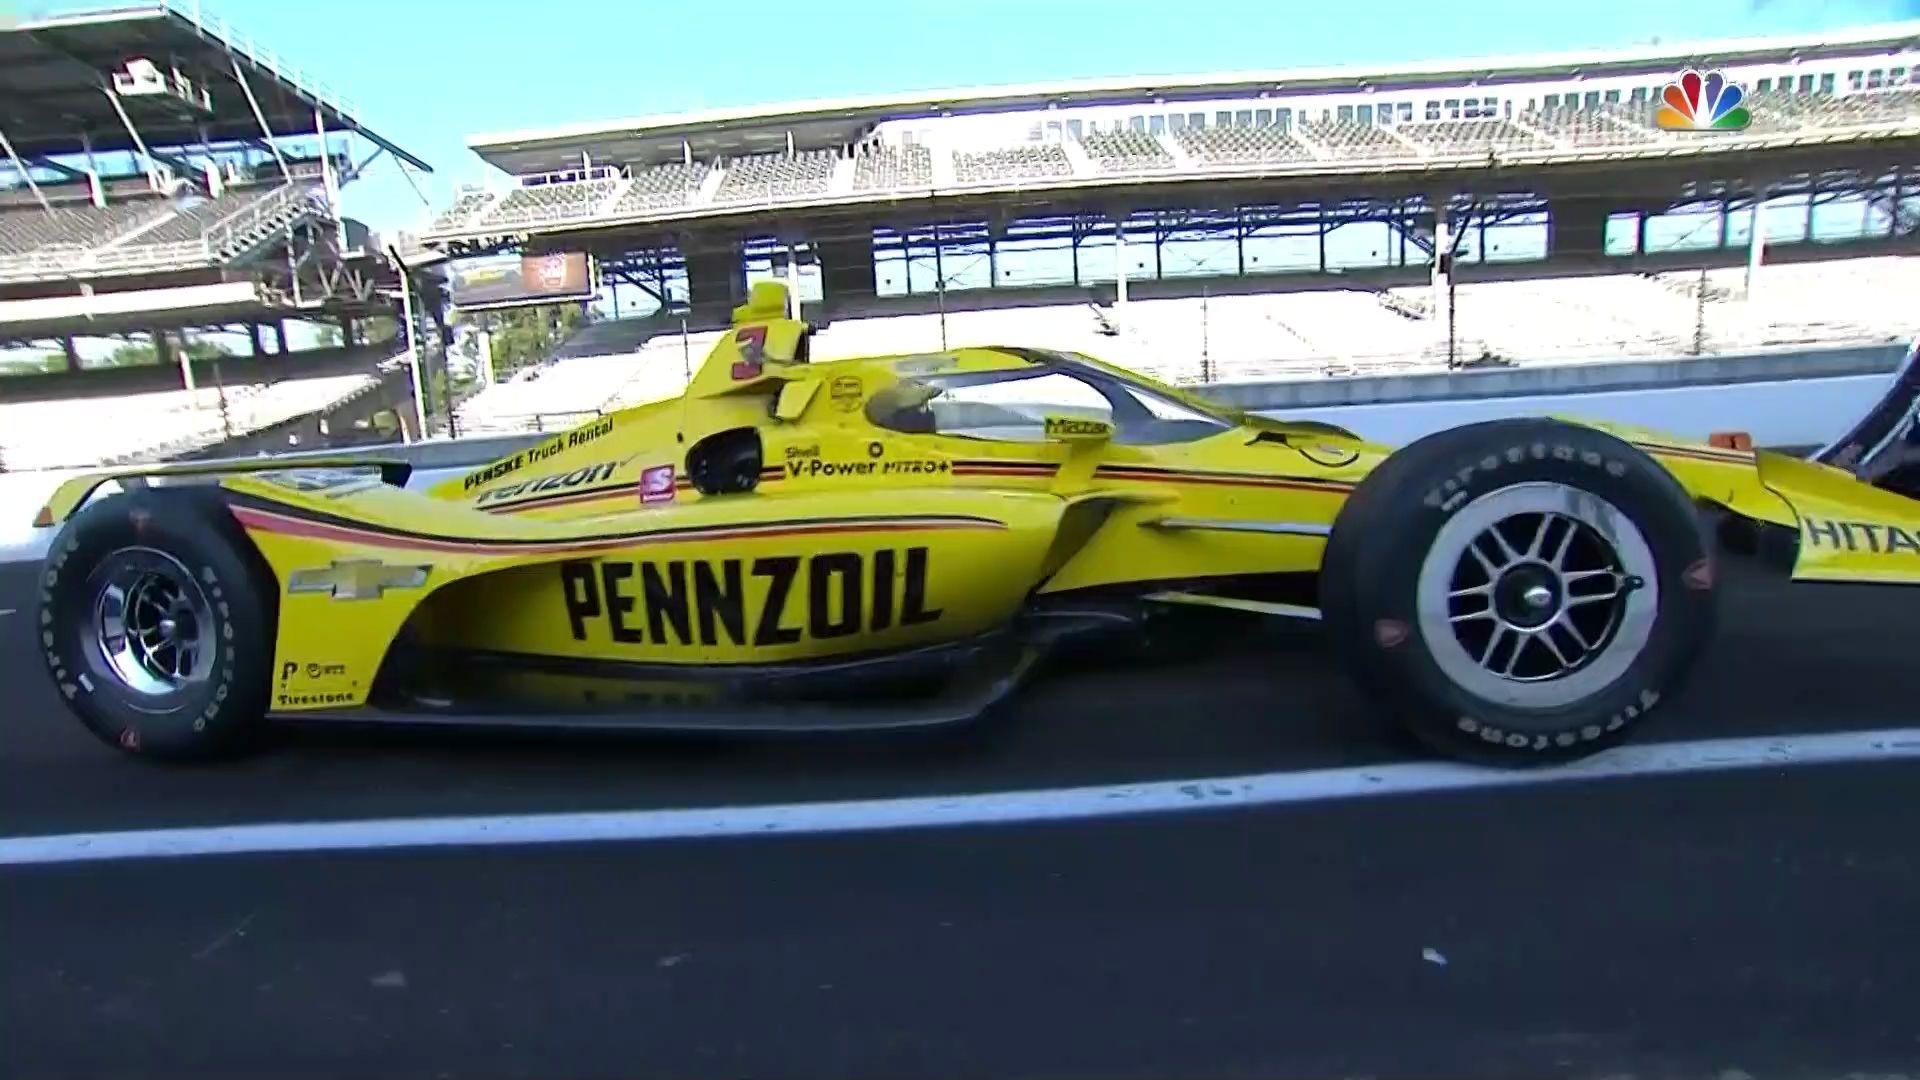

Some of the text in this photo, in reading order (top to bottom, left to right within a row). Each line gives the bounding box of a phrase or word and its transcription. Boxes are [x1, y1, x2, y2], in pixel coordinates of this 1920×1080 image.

[464, 417, 614, 490] PENSKE Truck Rental
[1804, 515, 1920, 554] HITA
[560, 546, 944, 647] PENNZOIL
[277, 692, 354, 704] Firestone
